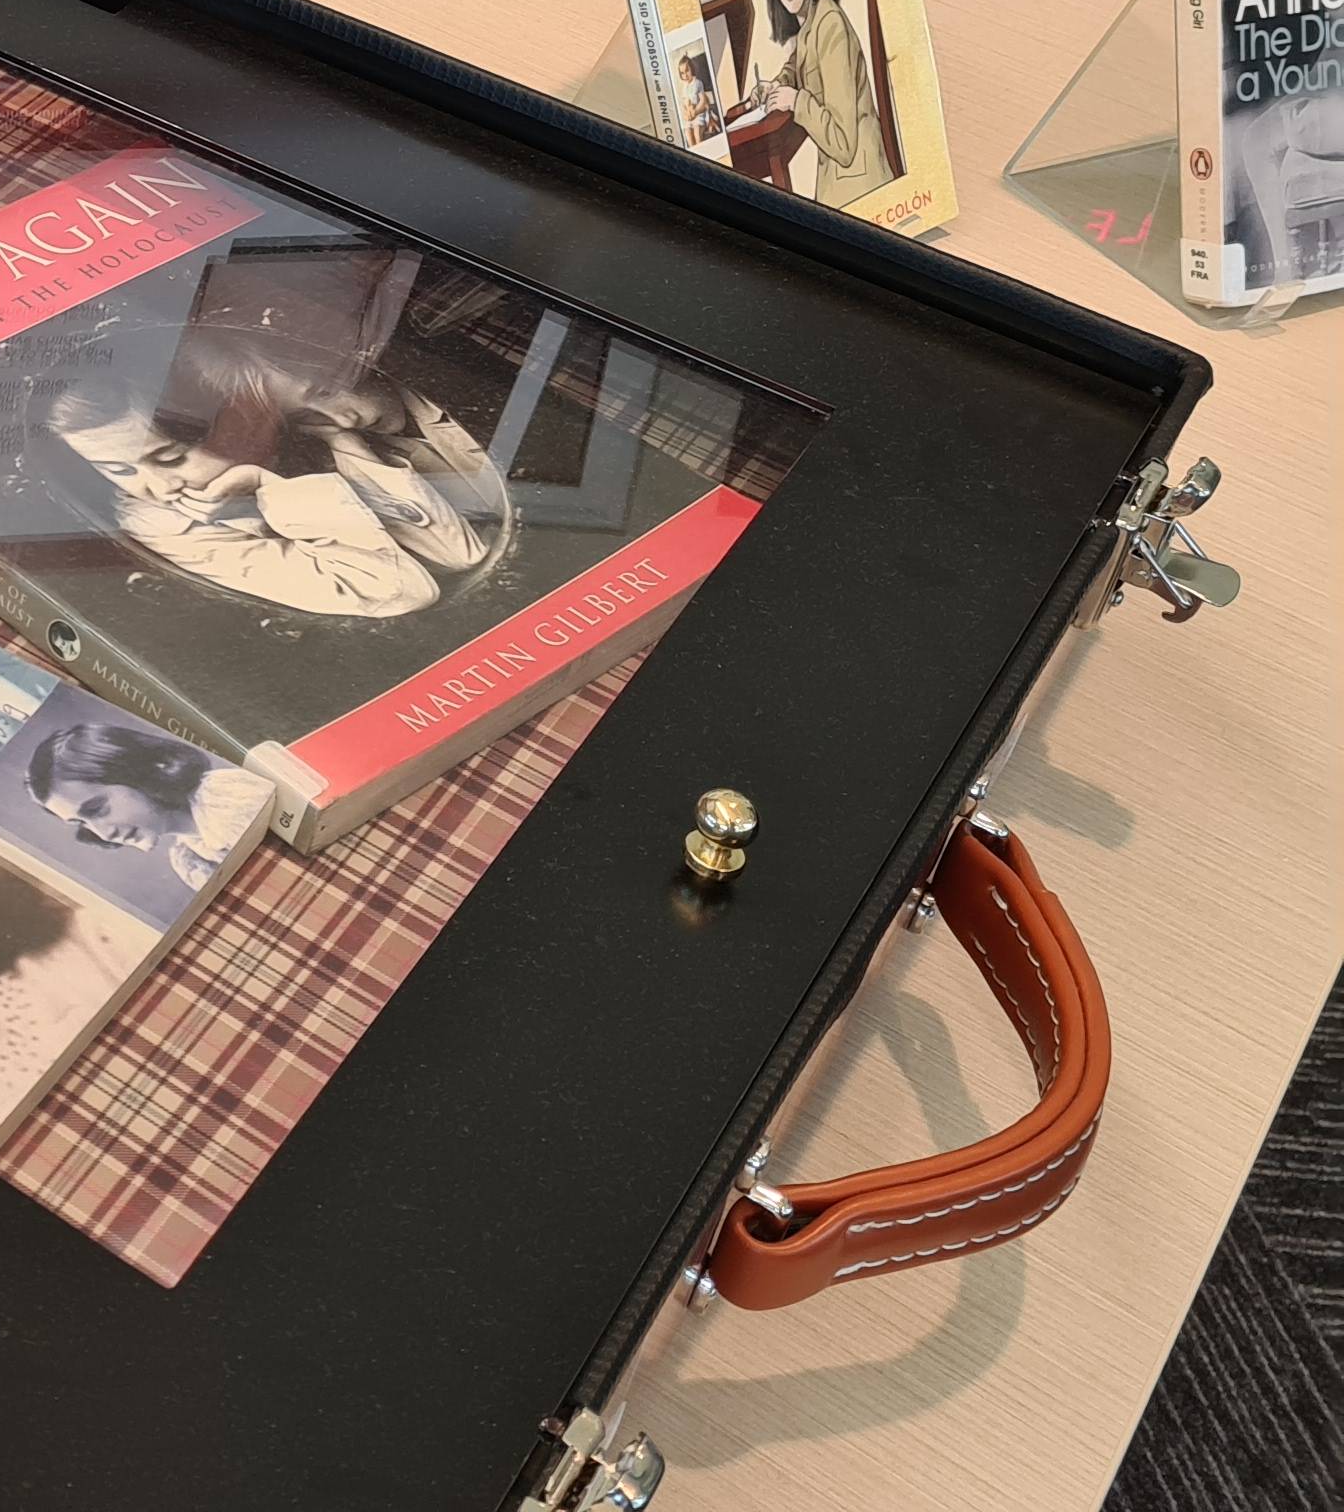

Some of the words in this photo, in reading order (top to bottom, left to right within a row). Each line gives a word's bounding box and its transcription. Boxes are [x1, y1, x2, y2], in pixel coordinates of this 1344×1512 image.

[638, 1, 648, 19] SID
[1190, 9, 1204, 30] Girl
[639, 20, 661, 76] JACOBSON
[1234, 22, 1292, 62] The
[1236, 71, 1260, 101] a
[1265, 58, 1344, 97] Youn
[658, 94, 671, 124] ERNIE
[13, 277, 73, 315] THE
[78, 198, 240, 280] HOLOCAUST
[1190, 270, 1209, 281] FRA
[8, 584, 29, 606] OF
[394, 642, 538, 735] MARTIN
[533, 557, 670, 648] GILBERT
[92, 659, 164, 721] MARTIN
[279, 811, 294, 830] GIL
